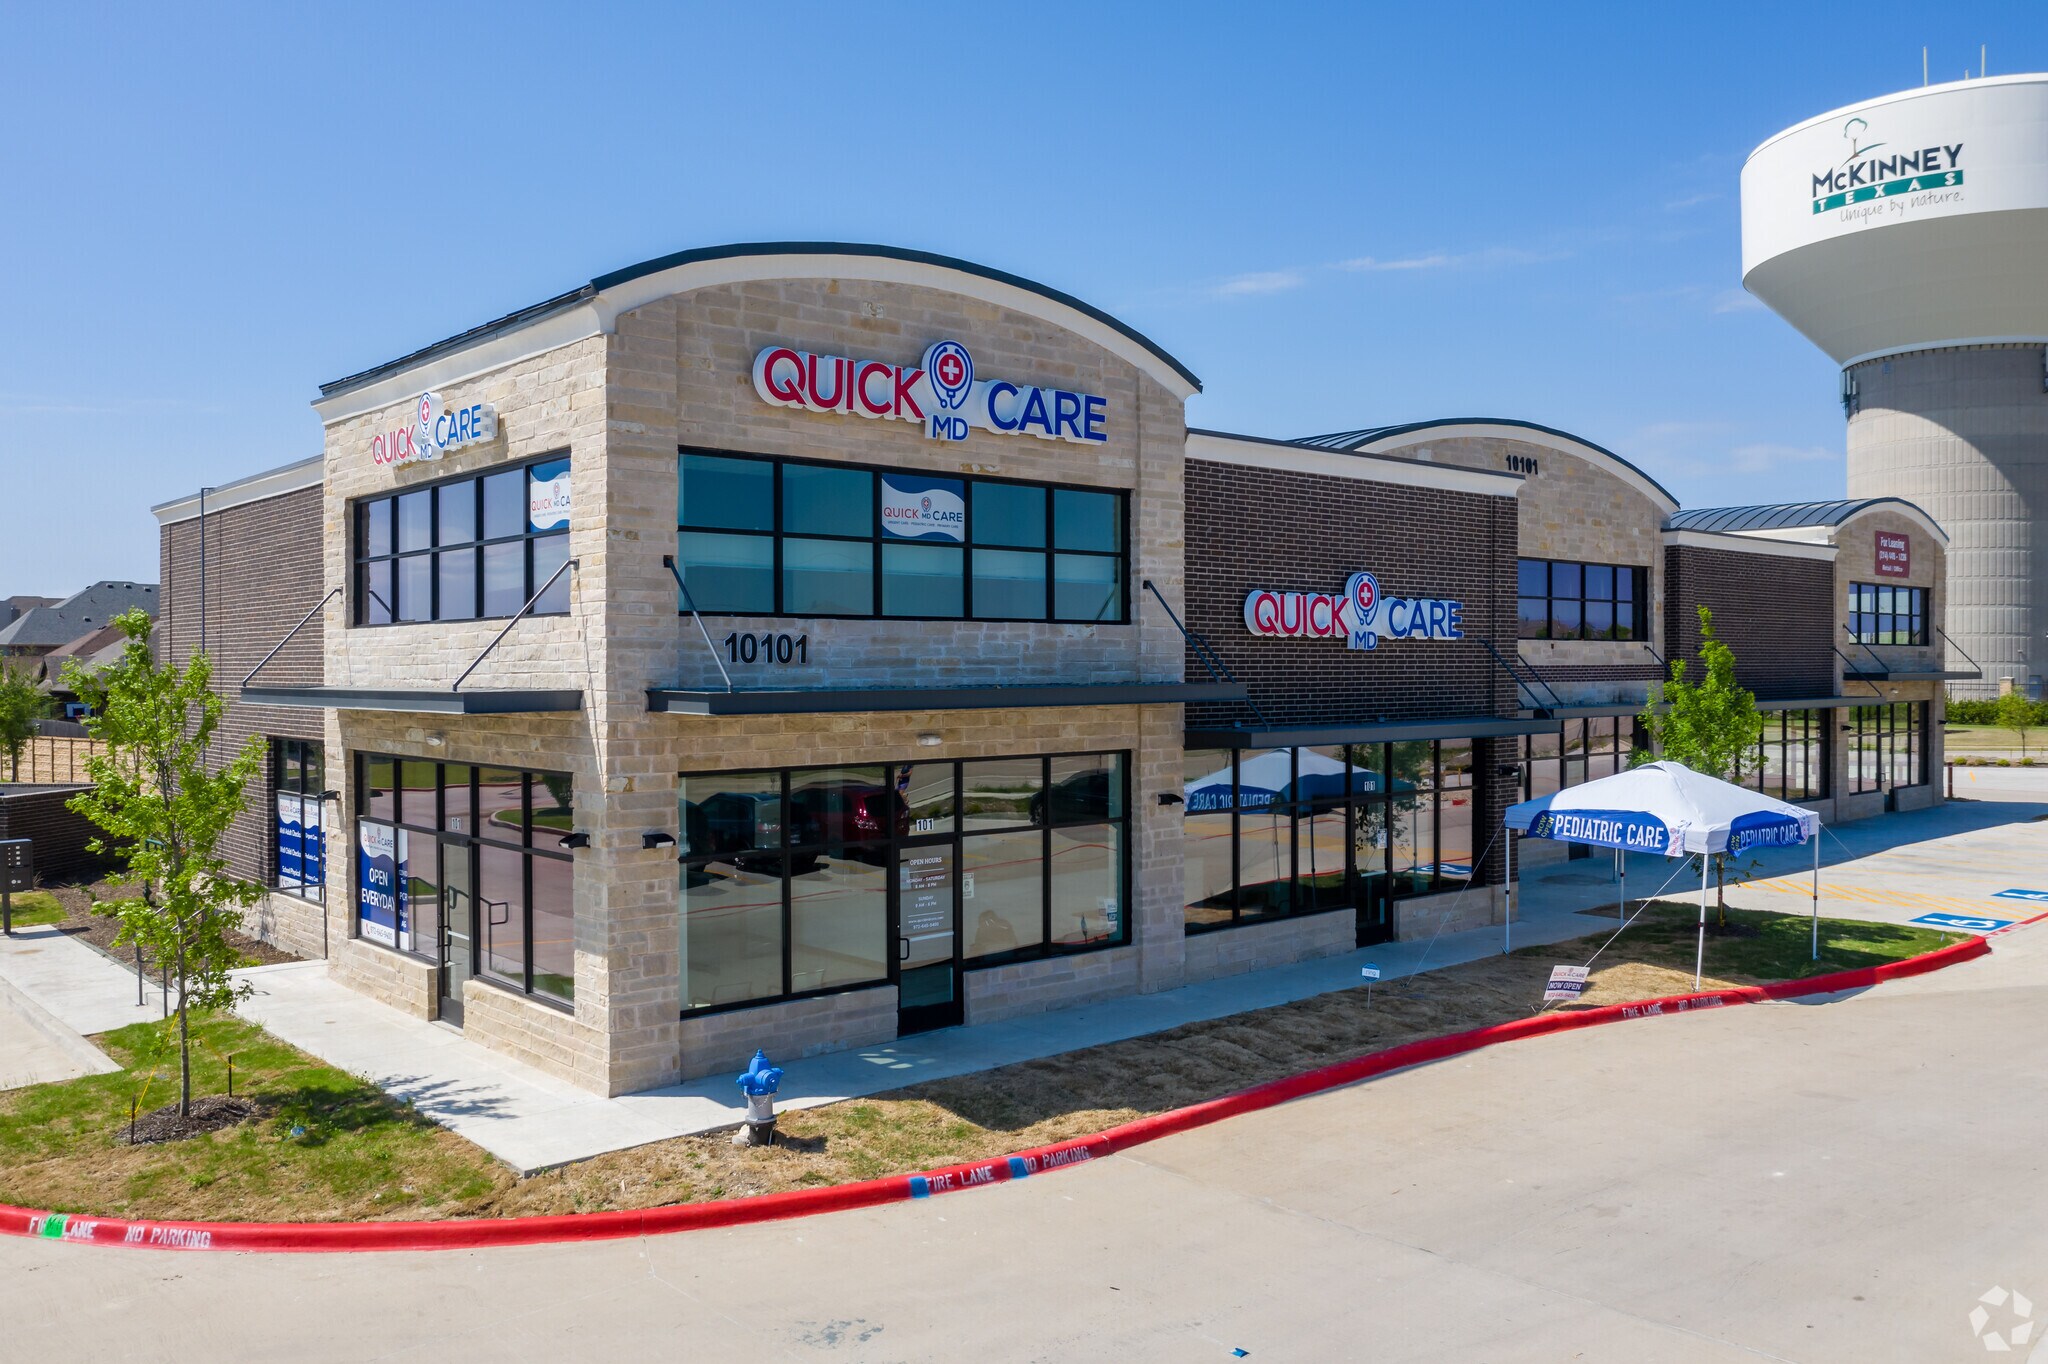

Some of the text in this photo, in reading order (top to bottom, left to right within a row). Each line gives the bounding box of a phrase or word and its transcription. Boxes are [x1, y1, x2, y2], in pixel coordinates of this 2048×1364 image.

[1812, 143, 1964, 198] McKINNEY
[1818, 172, 1957, 212] TEXAS
[1840, 191, 1965, 224] Unique by nature.
[763, 348, 1108, 442] QUICK MD CARE
[372, 404, 482, 465] QUICK MD CARE
[1505, 454, 1538, 475] 10101
[531, 498, 553, 511] QUICK
[883, 507, 919, 519] QUICK
[932, 511, 963, 522] CARE
[1254, 593, 1464, 650] QUICK MD CARE
[723, 632, 807, 664] 10101
[1365, 782, 1376, 791] 101
[916, 819, 934, 831] 101
[1536, 815, 1547, 834] NOW
[1541, 816, 1554, 838] OPEN
[1554, 814, 1623, 843] PEDIATRIC
[1626, 823, 1665, 848] CARE
[1740, 826, 1779, 848] PEDIATRIC
[1780, 823, 1800, 845] CARE
[924, 856, 943, 864] HOURS
[368, 867, 388, 886] OPEN
[361, 888, 395, 912] EVERYDAY
[1549, 982, 1582, 990] NOW OPEN
[1642, 1001, 1663, 1016] LANE
[1677, 1000, 1689, 1011] NO
[1691, 995, 1723, 1009] PARKING
[960, 1165, 994, 1185] LANE
[1042, 1145, 1091, 1168] PARKING
[62, 1221, 99, 1240] LANE
[125, 1226, 144, 1243] NO
[150, 1227, 212, 1249] PARKING
